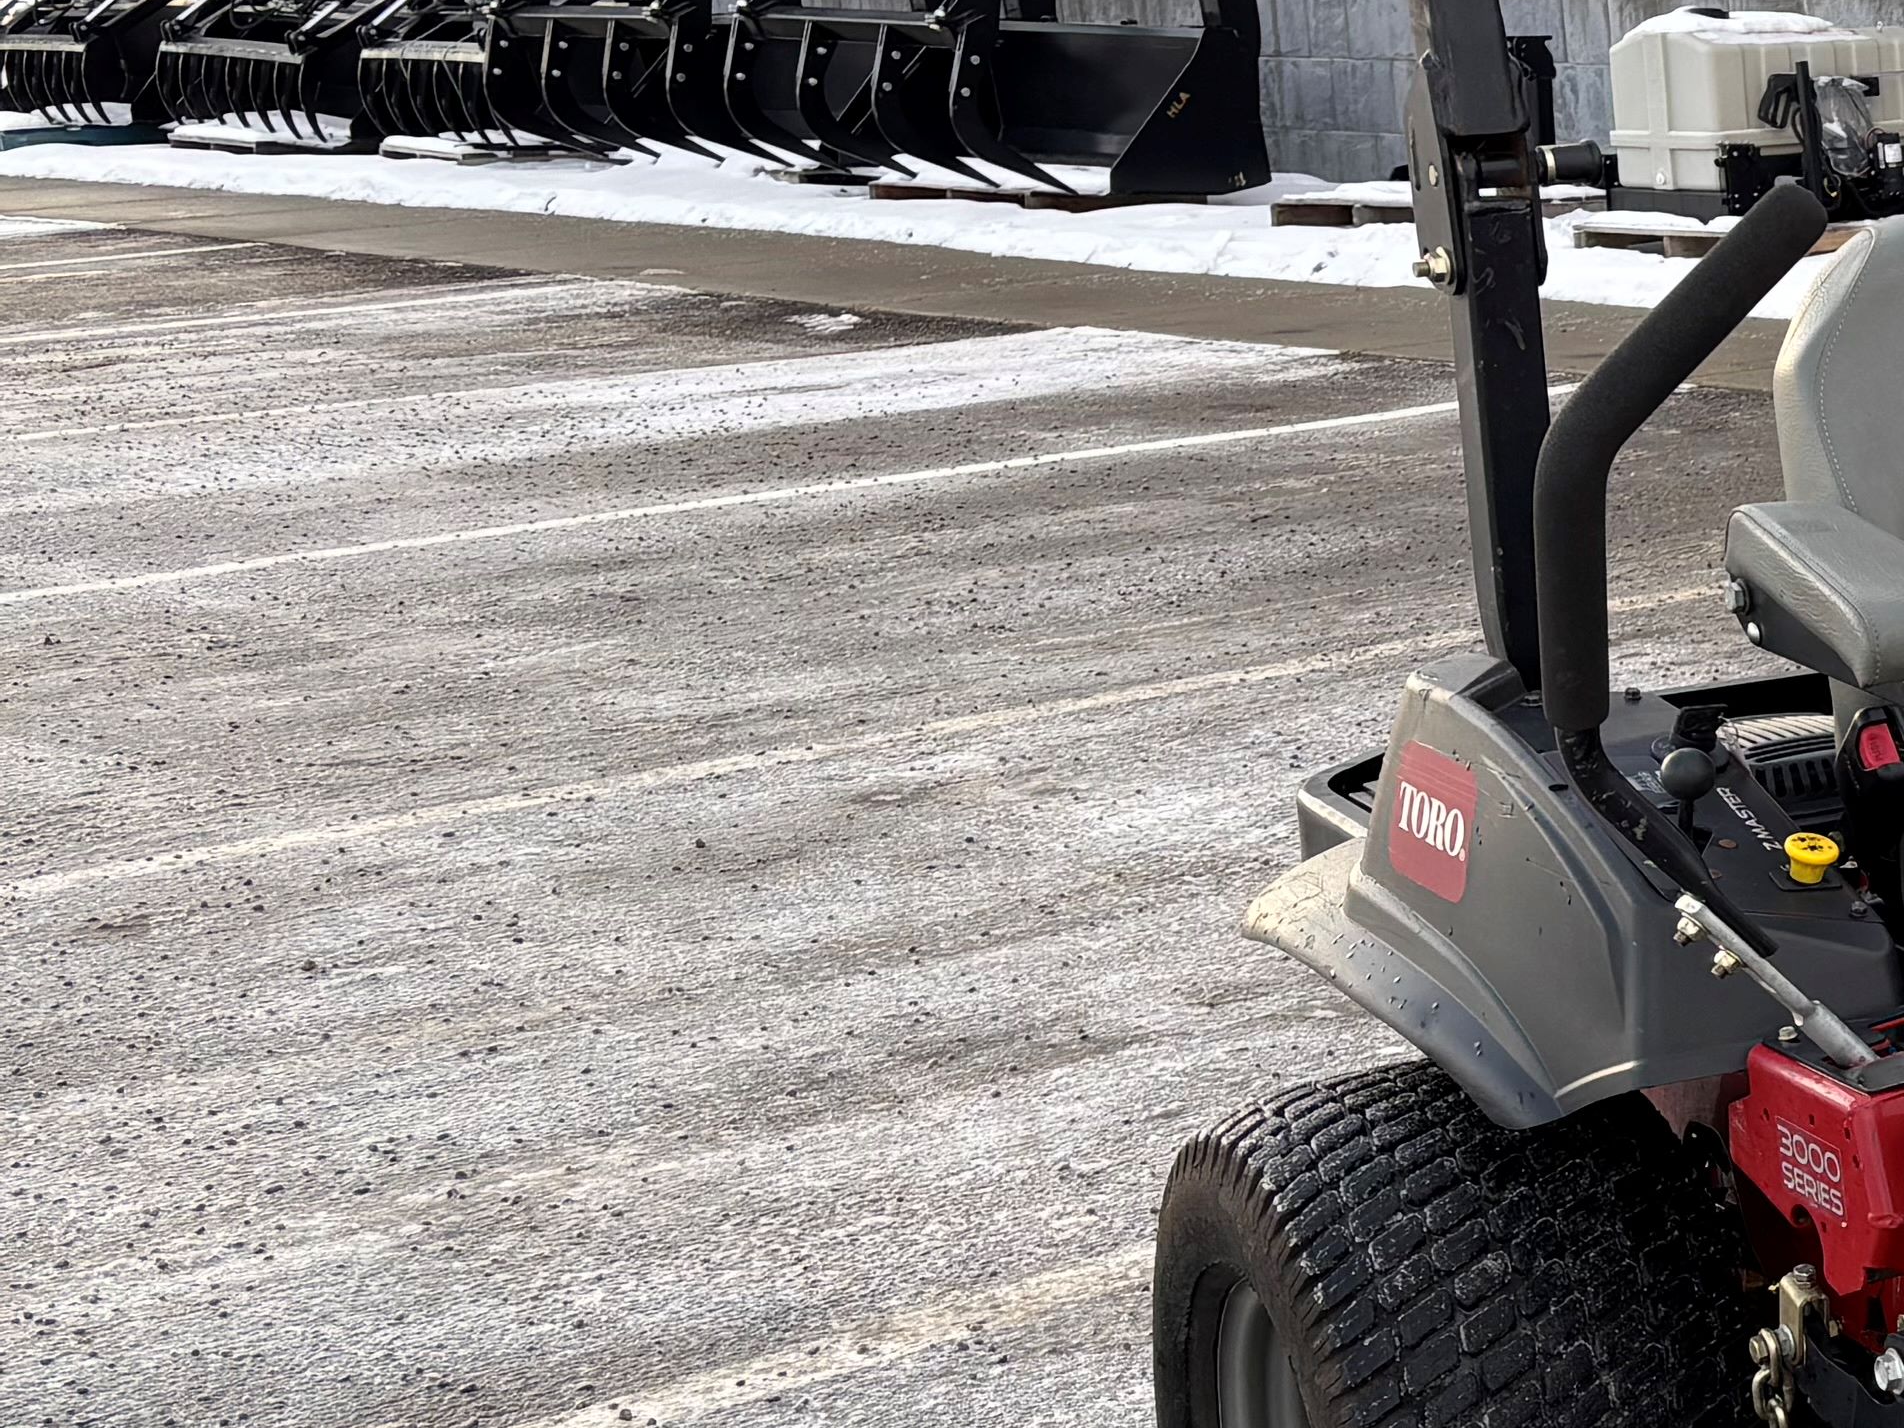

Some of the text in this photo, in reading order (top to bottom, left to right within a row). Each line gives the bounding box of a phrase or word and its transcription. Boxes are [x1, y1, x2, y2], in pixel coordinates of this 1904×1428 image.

[1166, 92, 1190, 118] HLA
[1398, 781, 1465, 857] TORO
[1716, 787, 1774, 840] MASTER
[1777, 1124, 1840, 1183] 3000
[1782, 1161, 1844, 1216] SERIES
